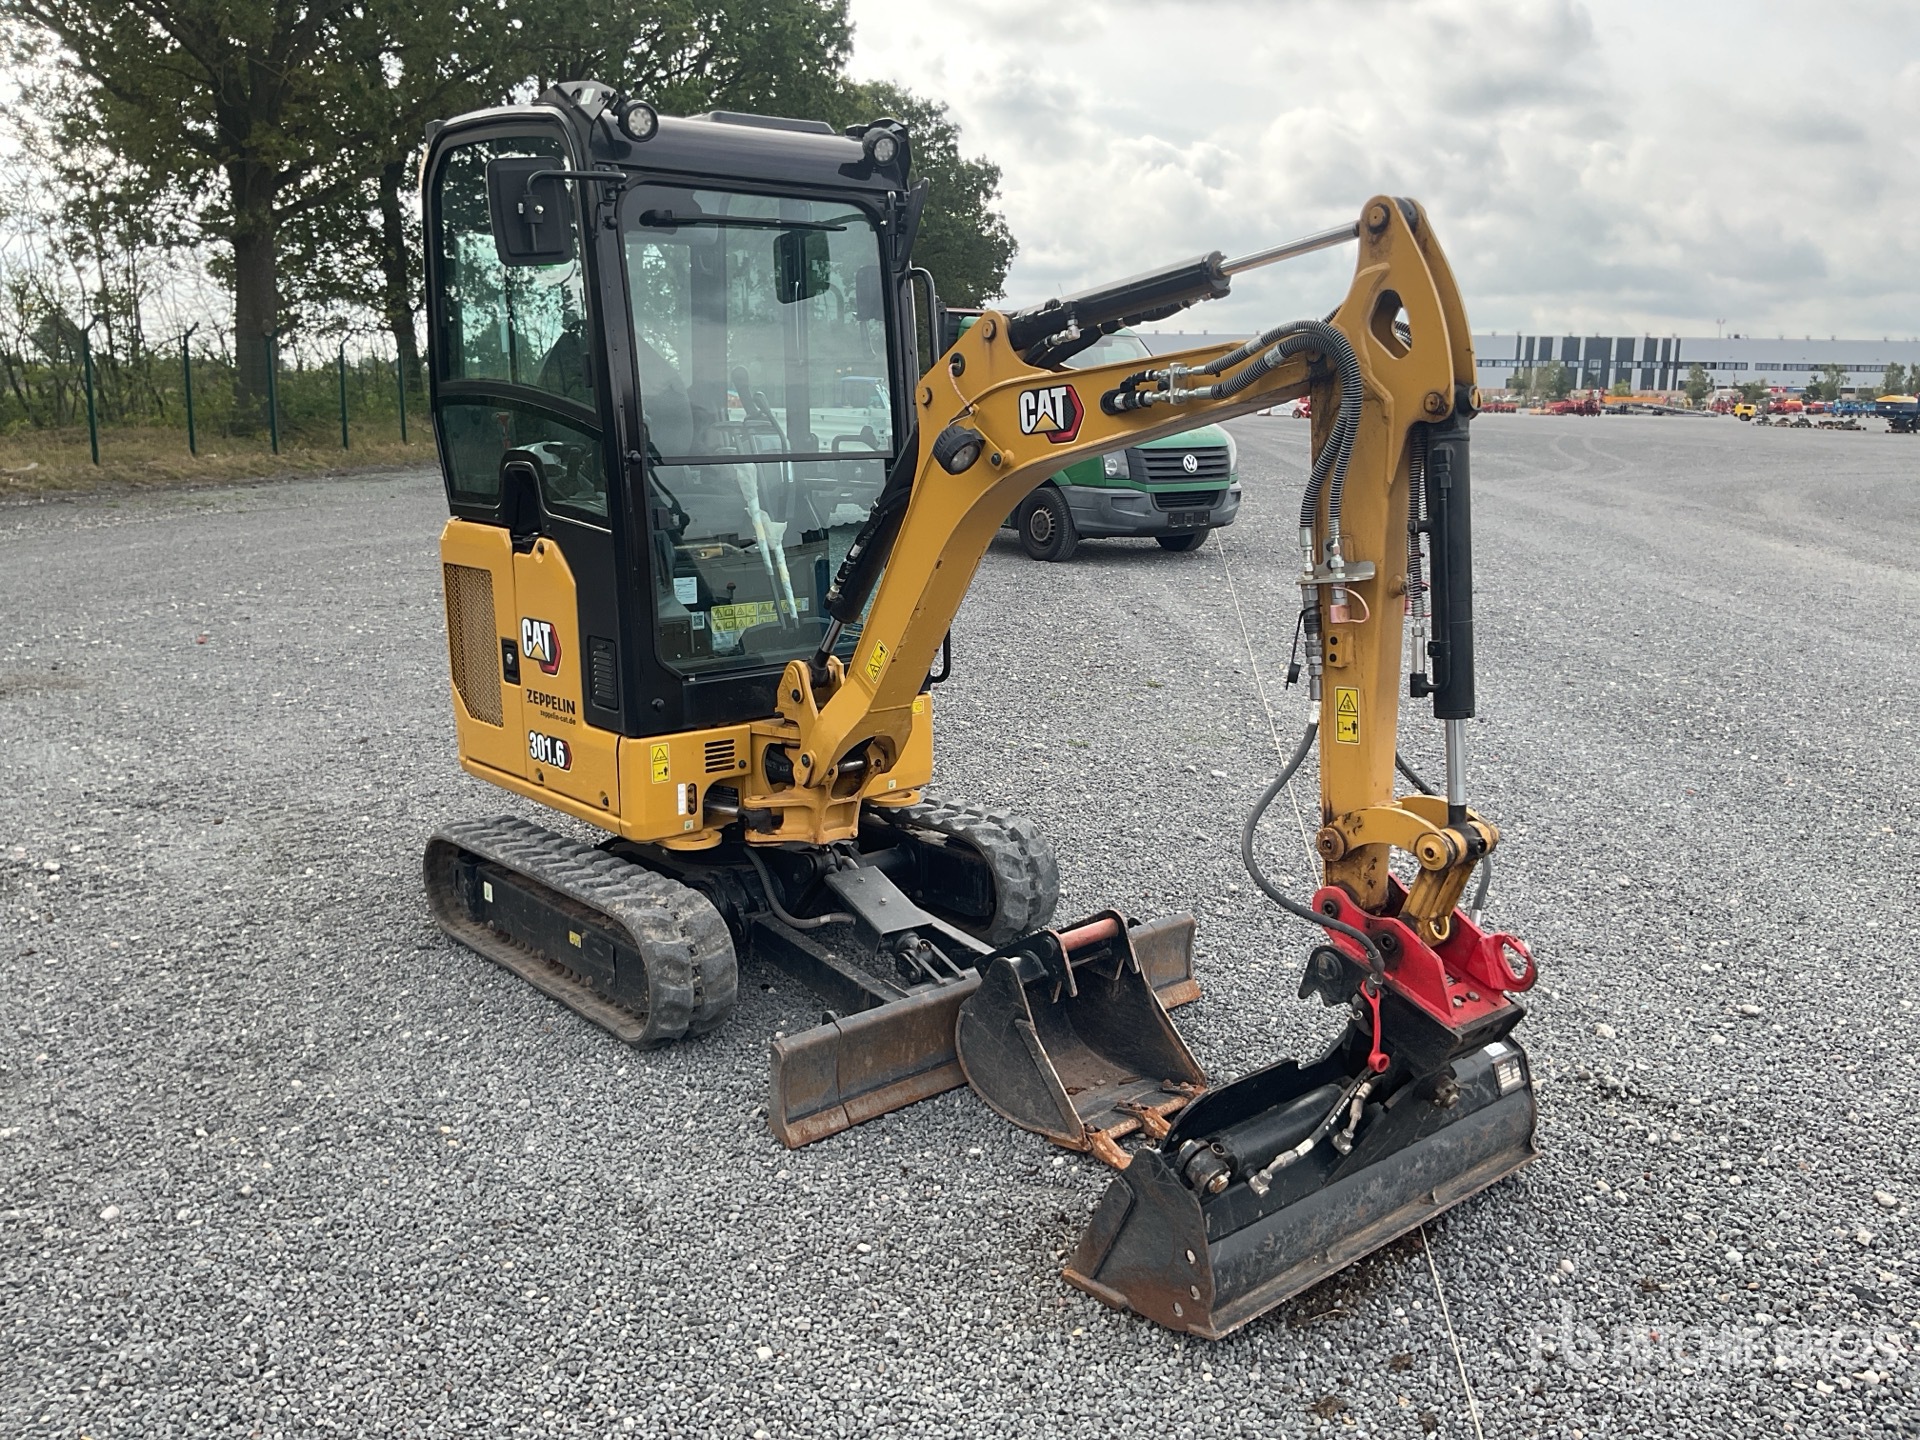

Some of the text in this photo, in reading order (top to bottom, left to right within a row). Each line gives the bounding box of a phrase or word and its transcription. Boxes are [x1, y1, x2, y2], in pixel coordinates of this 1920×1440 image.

[1019, 386, 1067, 434] CAT
[521, 617, 551, 662] CAT
[526, 688, 576, 715] ZEPPELIN
[540, 709, 577, 726] zeppelin-cat.de
[528, 730, 566, 768] 301.6
